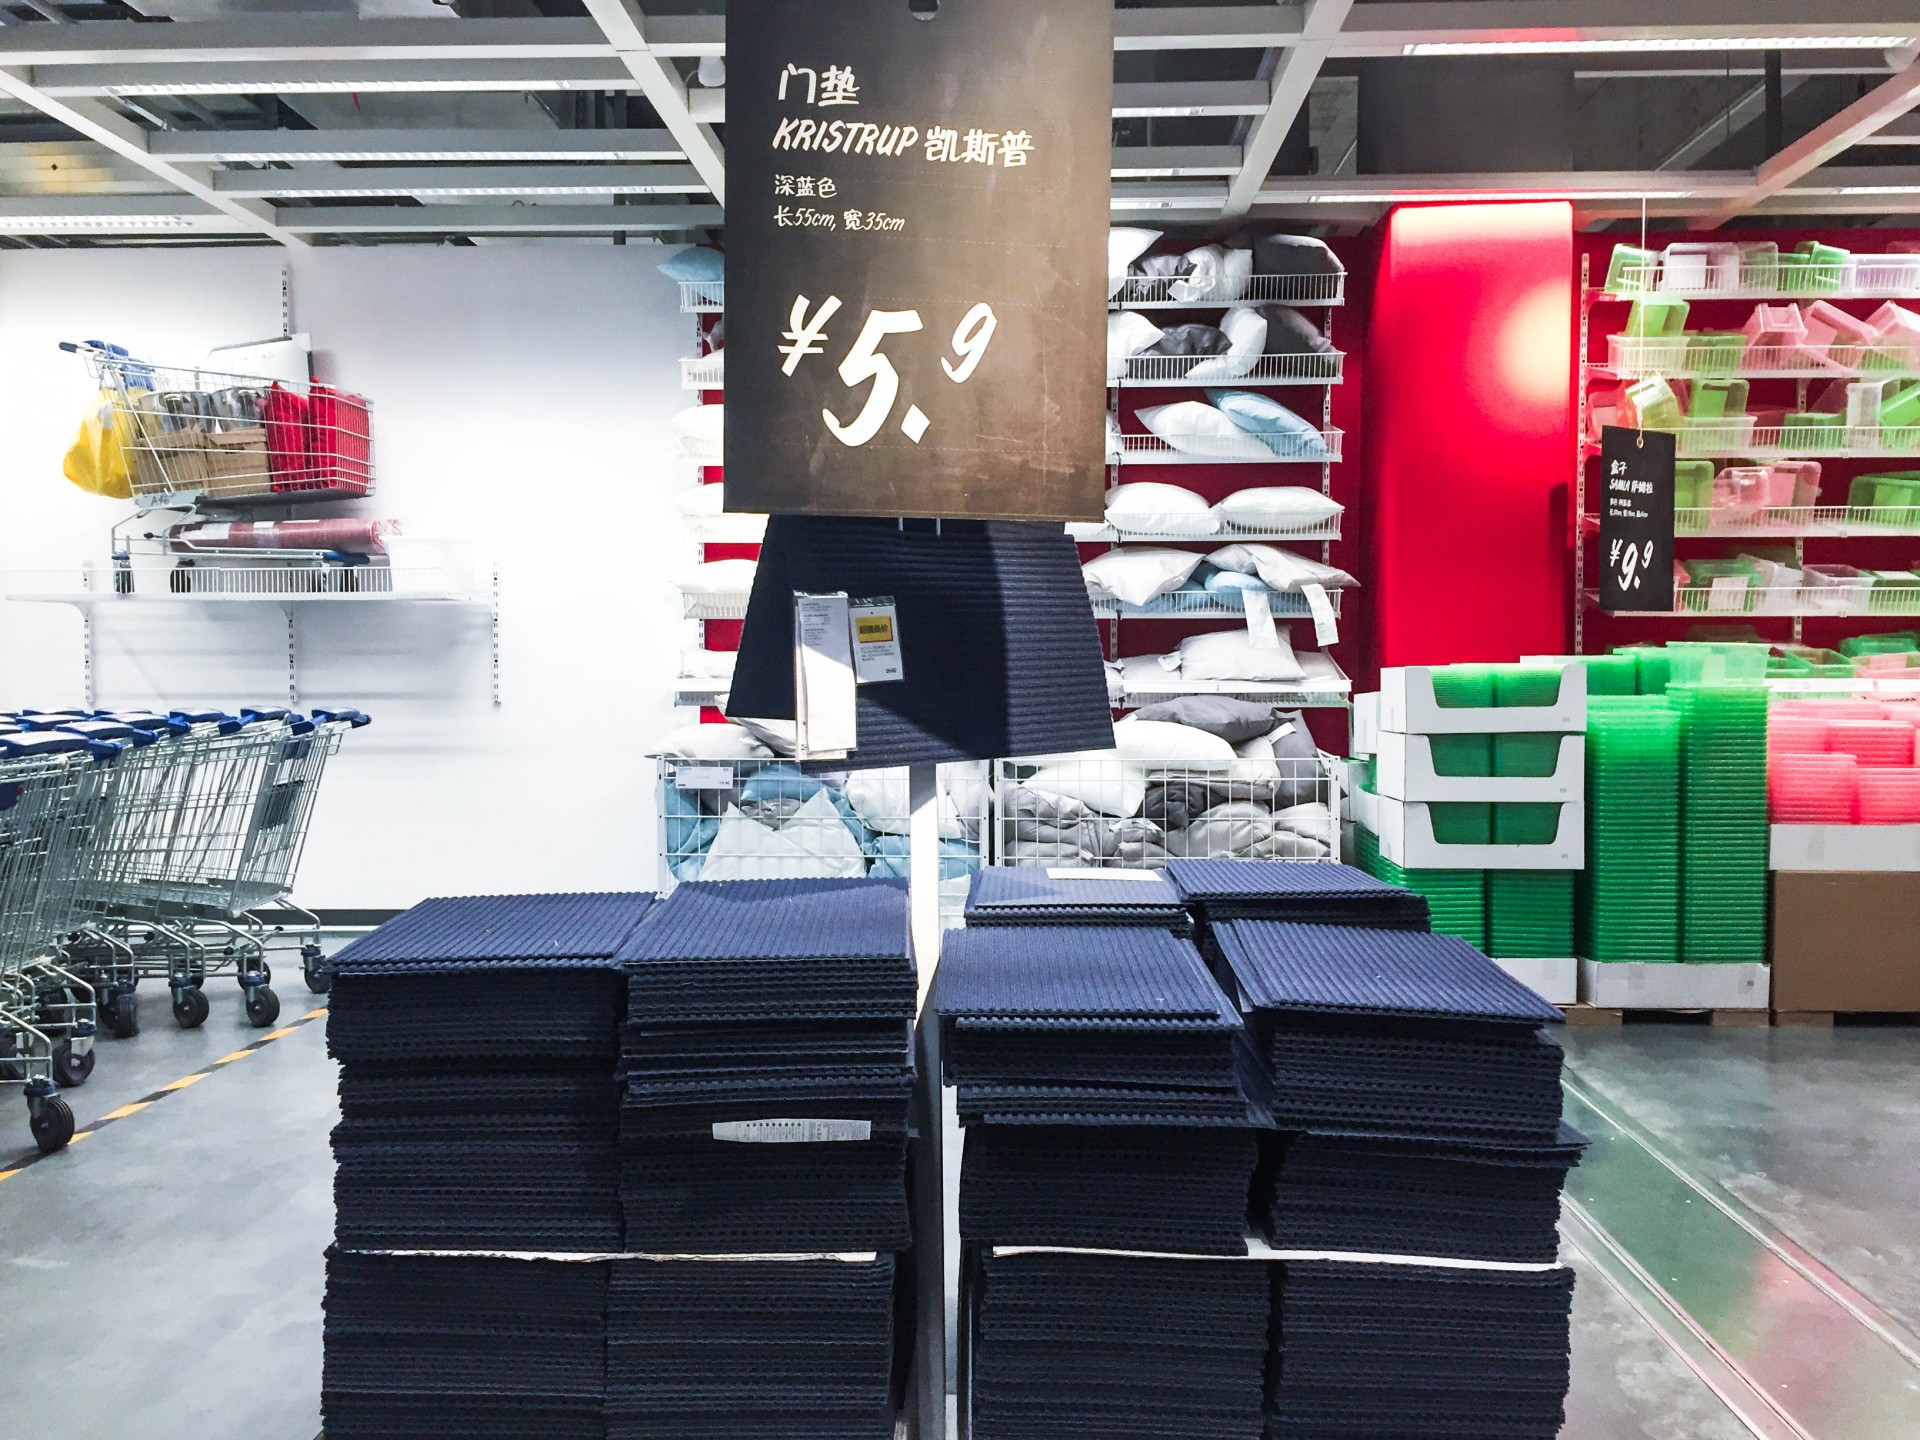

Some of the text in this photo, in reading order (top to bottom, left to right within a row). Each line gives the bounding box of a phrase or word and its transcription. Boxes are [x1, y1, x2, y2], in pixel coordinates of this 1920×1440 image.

[778, 62, 860, 107] 门垫
[772, 117, 1035, 168] KRISTRUP 凯斯普
[774, 174, 838, 199] 深蓝色
[773, 205, 906, 232] 长55cm, 宽35cm
